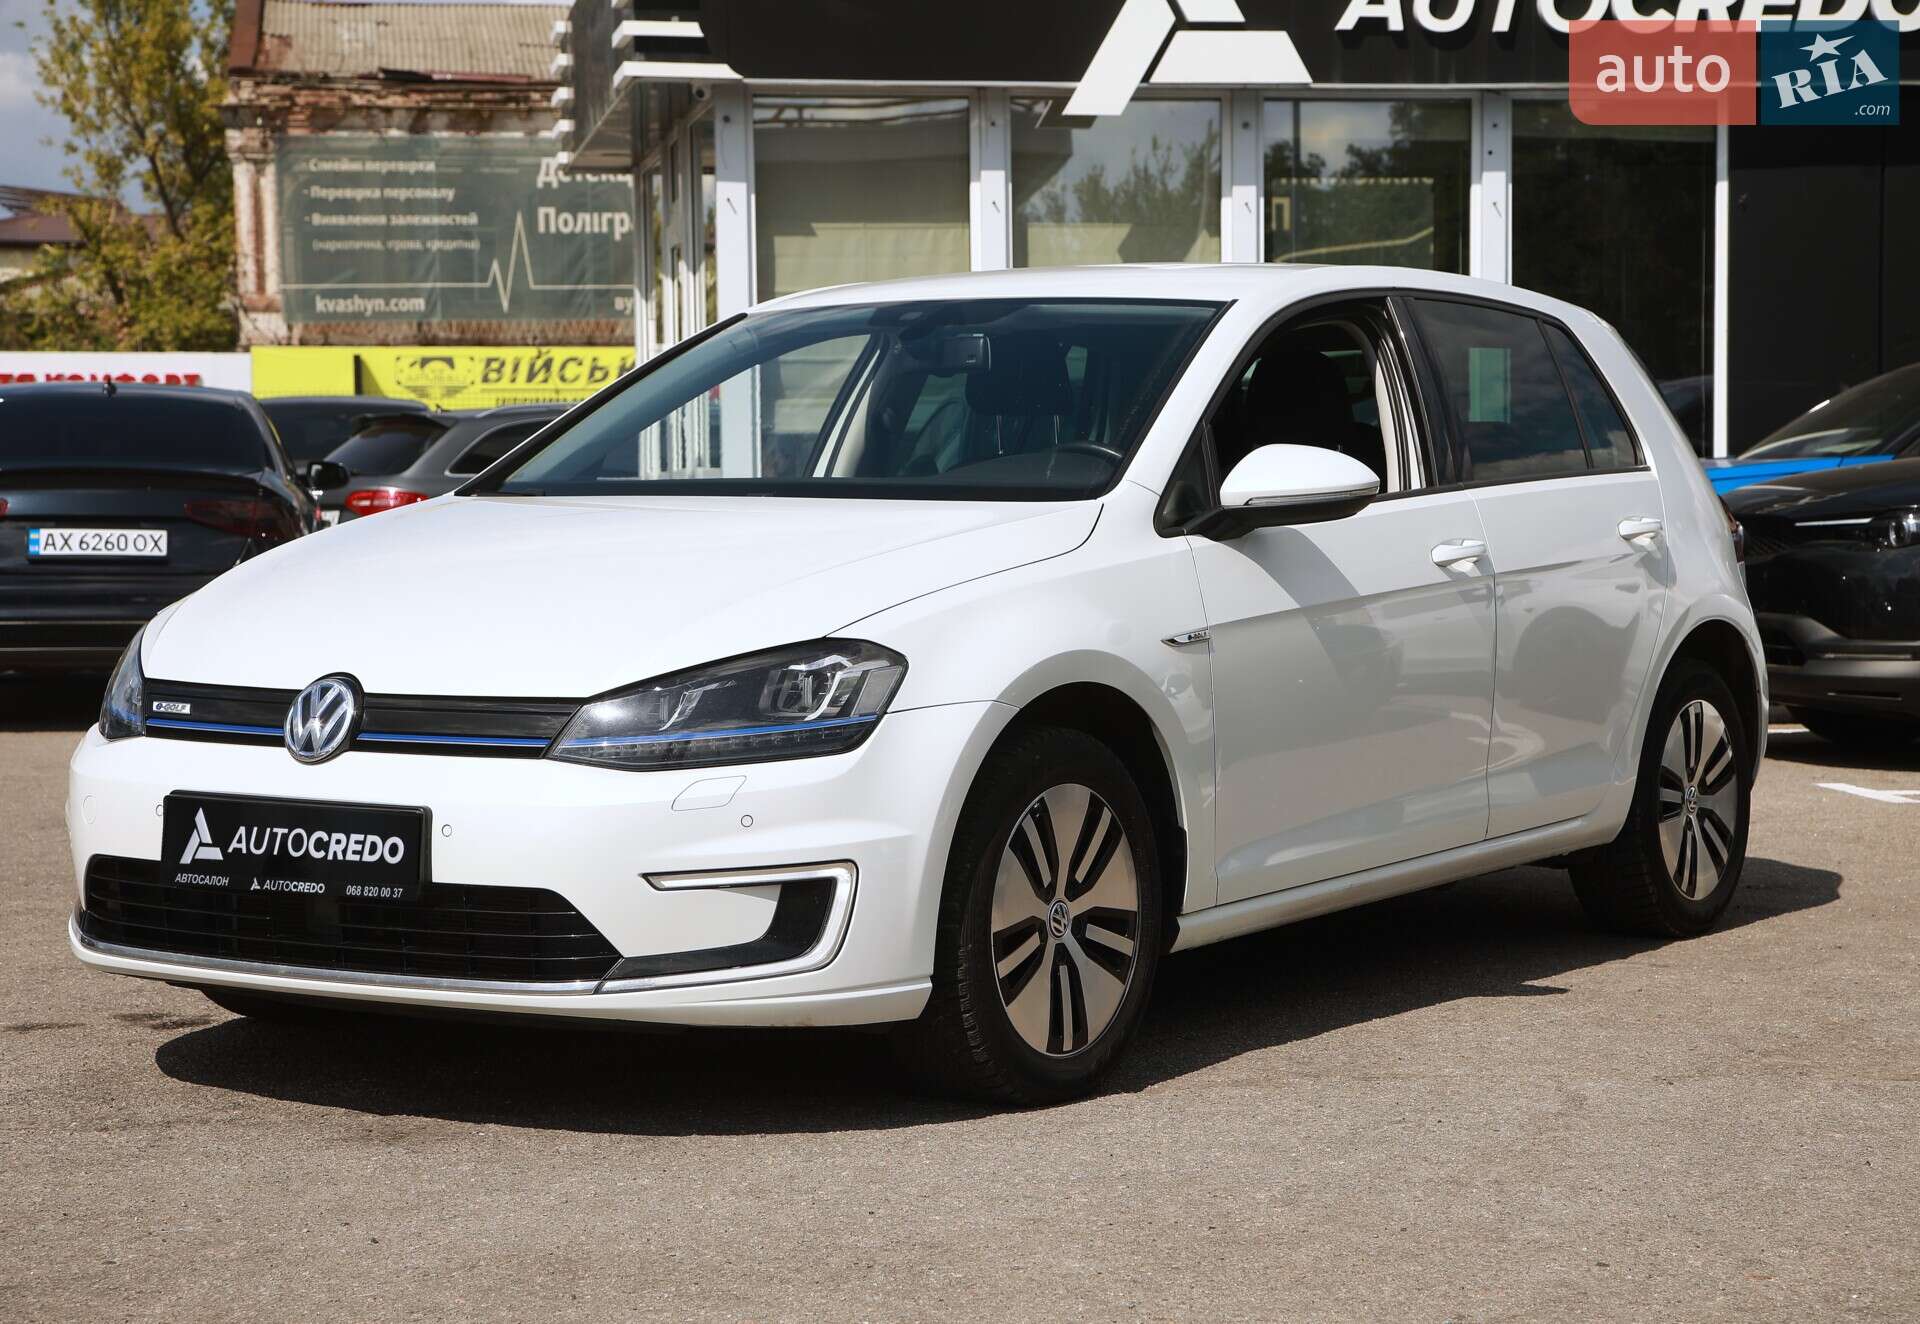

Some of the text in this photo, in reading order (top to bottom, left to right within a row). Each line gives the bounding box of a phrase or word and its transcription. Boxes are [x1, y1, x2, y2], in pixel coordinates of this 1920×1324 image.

[537, 206, 634, 242] Полігр
[315, 294, 426, 317] kvashyn.com
[44, 533, 163, 552] AX 6260 OX
[227, 825, 405, 865] AUTOCREDO
[174, 873, 230, 887] АВТОСАЛОН
[262, 879, 326, 894] AUTOCREDO
[346, 884, 403, 898] 068 820 00 37
